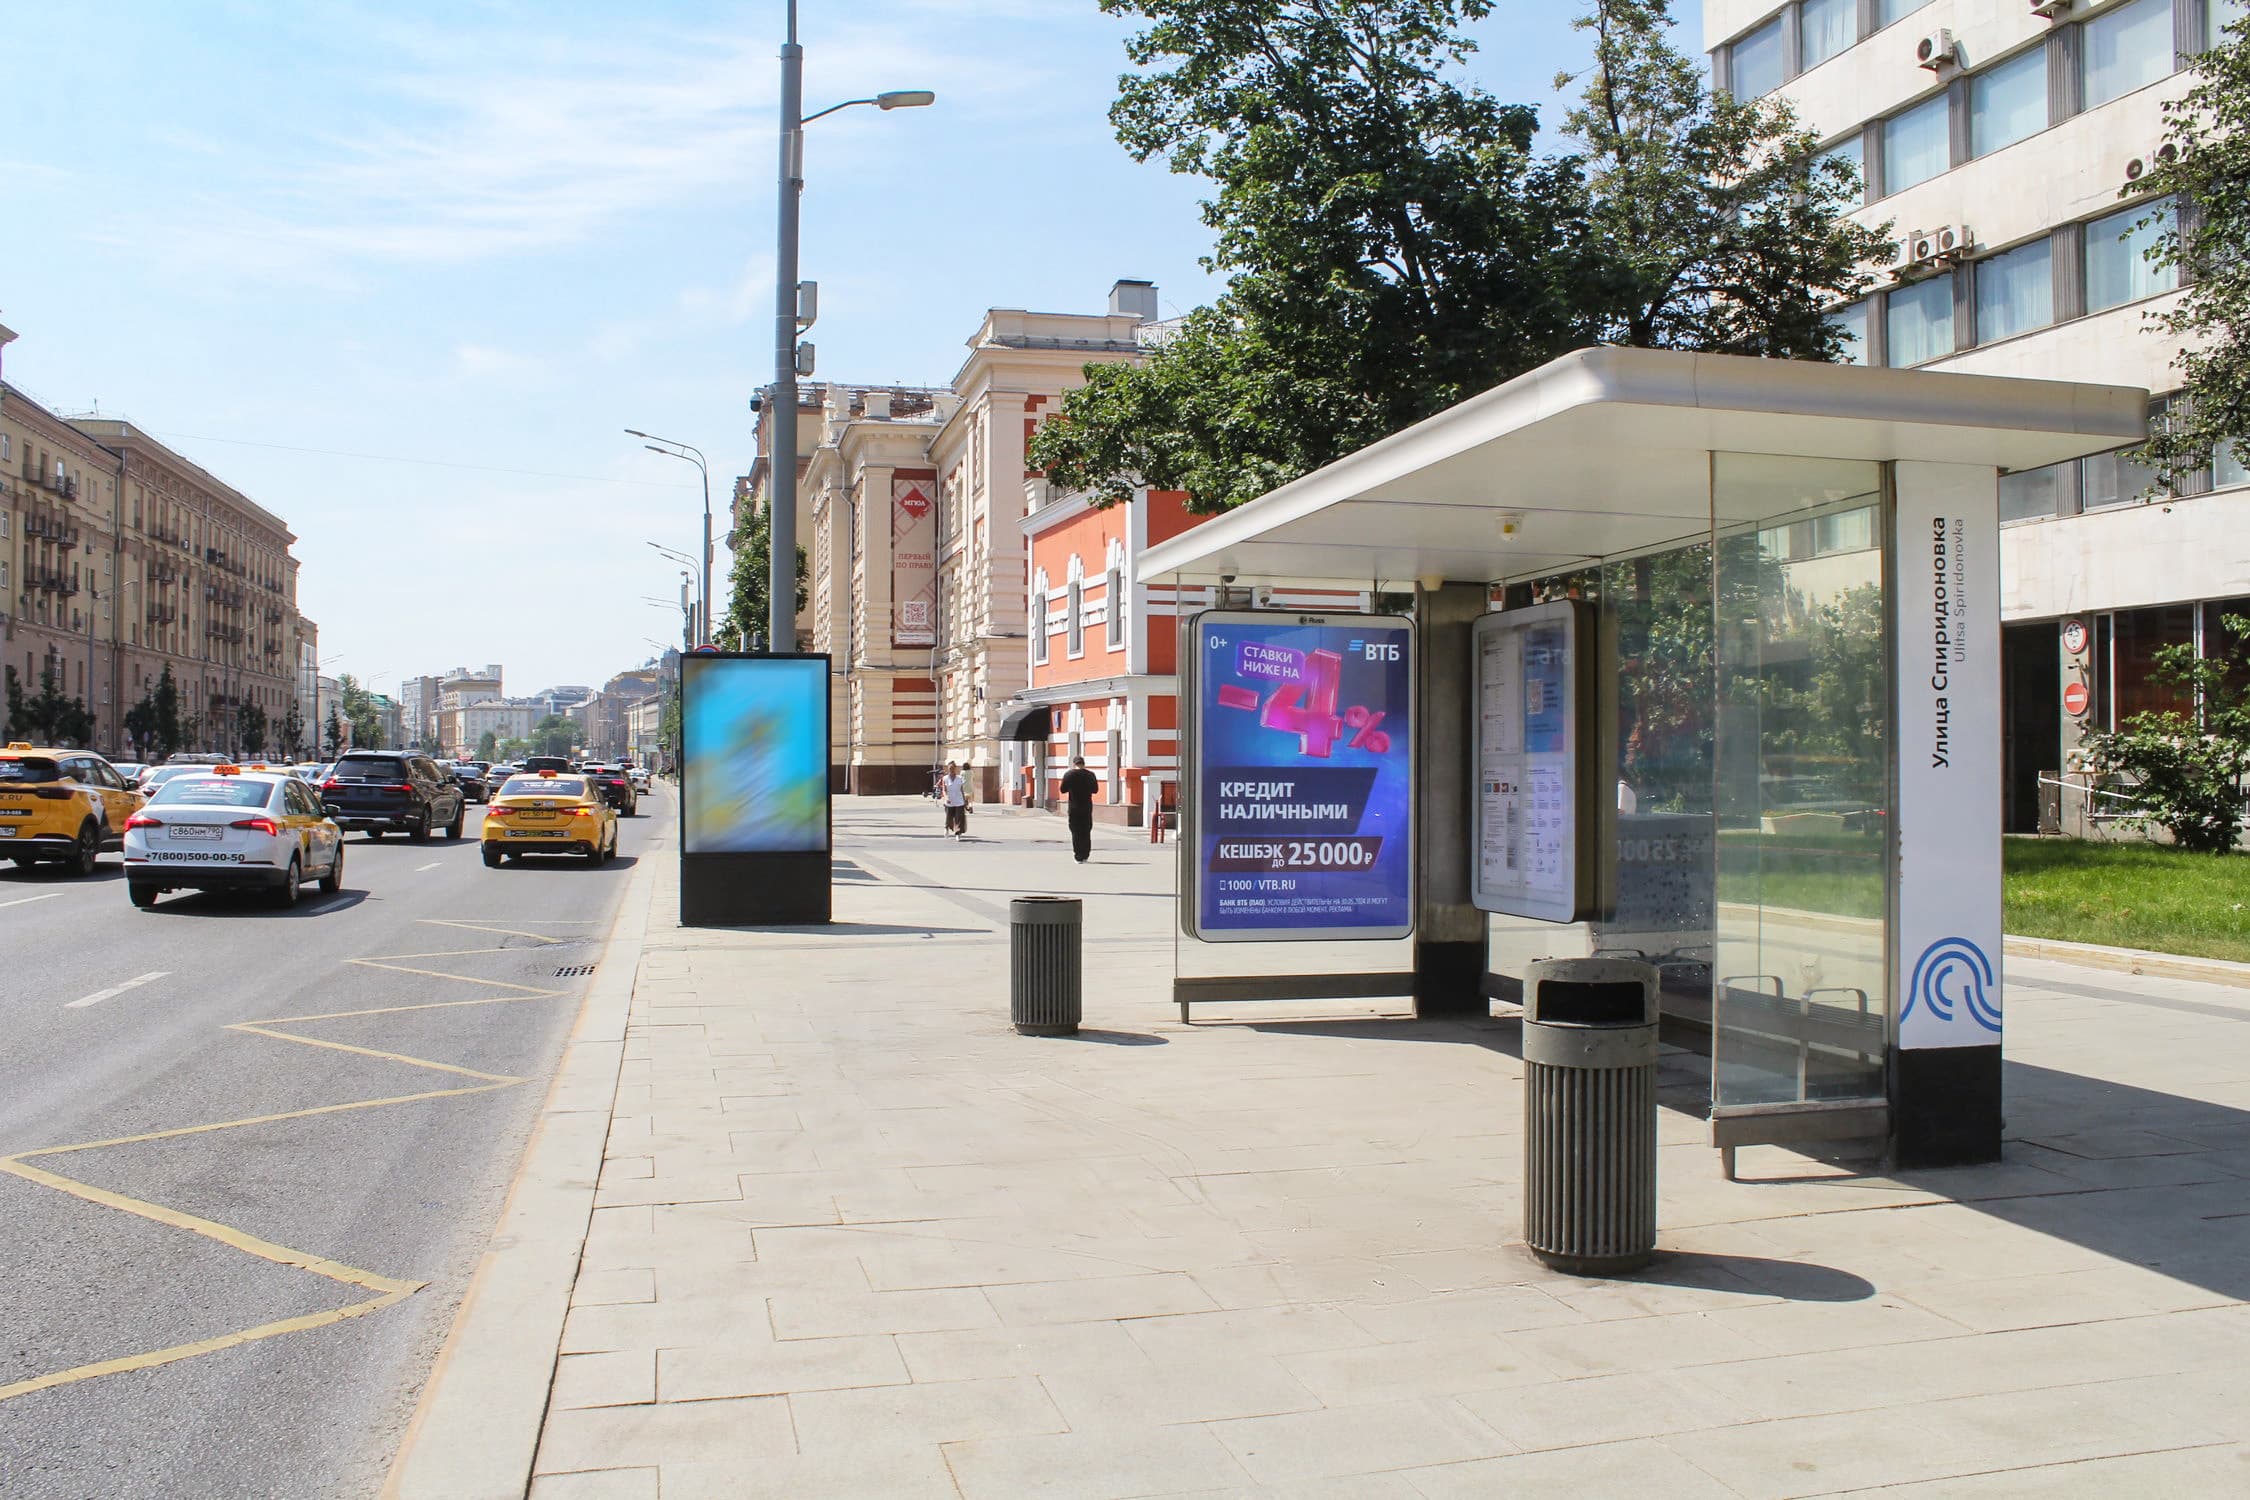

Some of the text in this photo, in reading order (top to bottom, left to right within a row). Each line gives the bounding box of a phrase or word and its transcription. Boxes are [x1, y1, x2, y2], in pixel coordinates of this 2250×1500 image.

[897, 552, 931, 560] ПЕРВЫЙ
[1953, 518, 1967, 662] Ulitsa Spiridonovka
[1209, 636, 1228, 649] 0+
[1932, 517, 1950, 769] Улица Спиридоновка
[1243, 646, 1293, 664] СТАВКИ
[1365, 643, 1400, 661] ВТБ
[1243, 660, 1300, 679] НИЖЕ НА
[1219, 781, 1295, 801] КРЕДИТ
[1219, 802, 1349, 820] НАЛИЧНЫМИ
[145, 851, 245, 862] +7(800)500-00-50
[1219, 843, 1284, 860] КЕШБЭК
[1272, 859, 1285, 868] ДО
